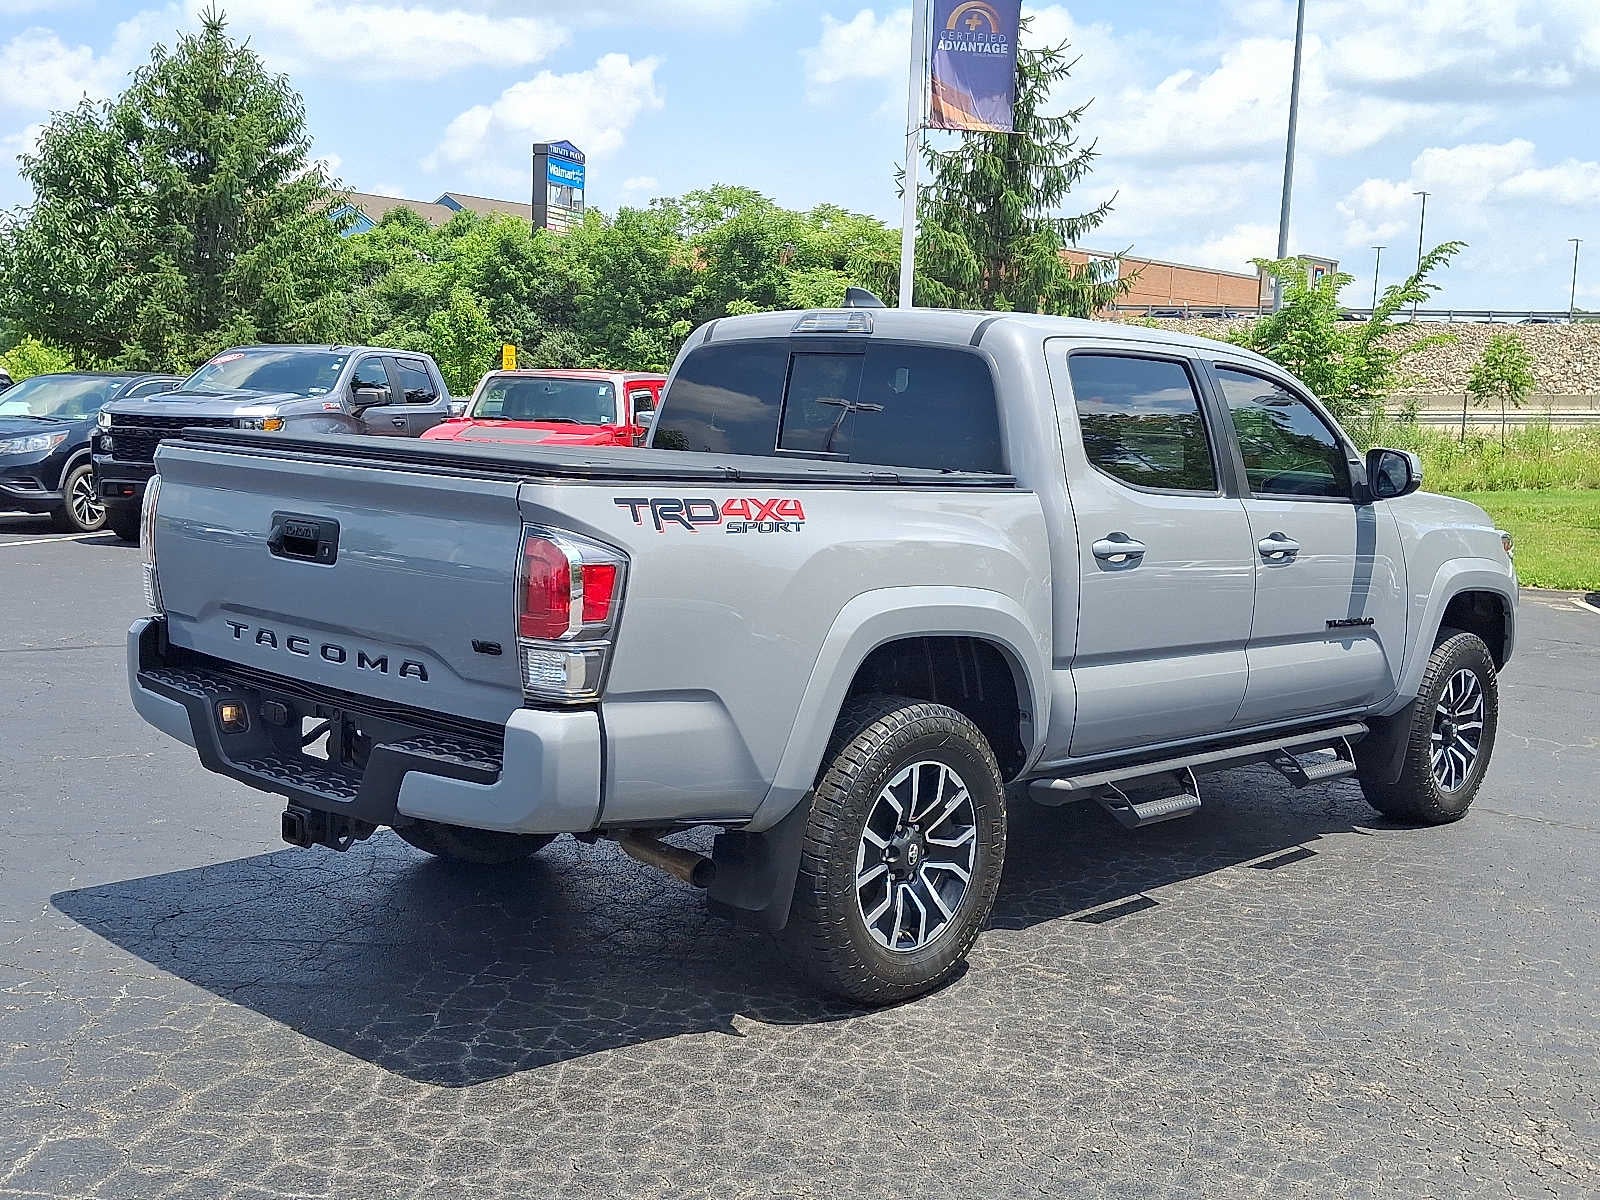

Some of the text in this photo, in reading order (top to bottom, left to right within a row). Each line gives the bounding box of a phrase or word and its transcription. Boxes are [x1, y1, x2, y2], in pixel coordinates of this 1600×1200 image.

[940, 30, 1007, 43] CERTIFIED
[937, 39, 1009, 54] ADVANTAGE
[549, 163, 575, 180] Walmart
[613, 497, 722, 533] TRD
[725, 521, 806, 534] SPORT
[226, 619, 429, 683] TACOMA
